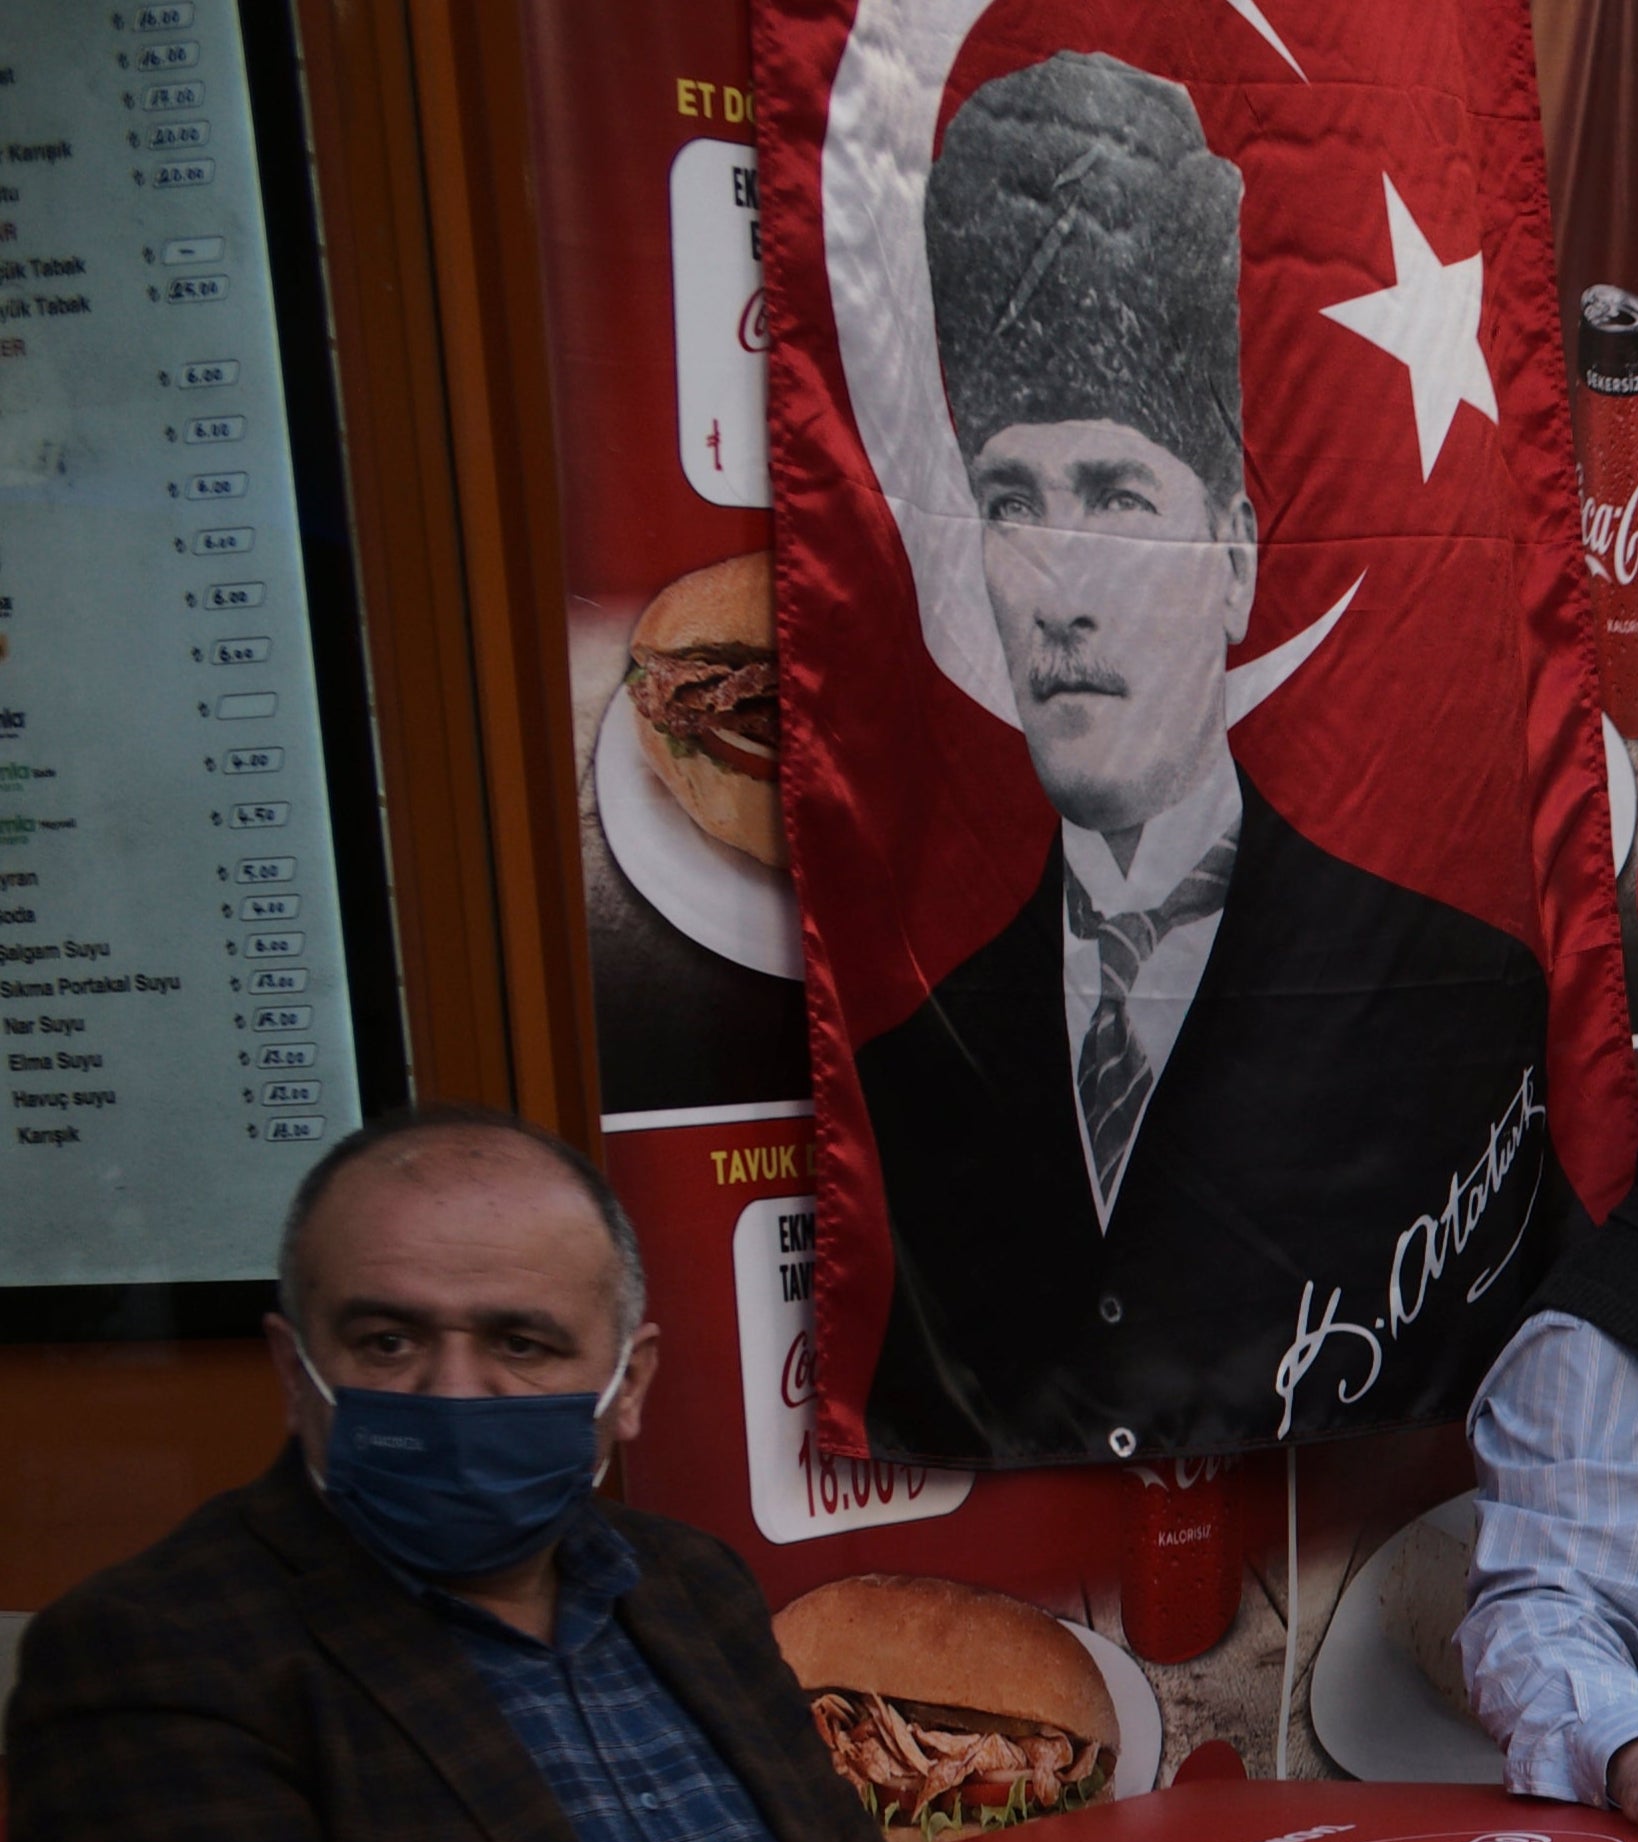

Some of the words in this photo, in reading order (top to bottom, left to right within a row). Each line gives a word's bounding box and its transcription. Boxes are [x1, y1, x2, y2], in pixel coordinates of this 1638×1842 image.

[675, 77, 717, 120] ET
[0, 872, 38, 892] yran
[0, 906, 35, 924] oda
[63, 940, 111, 962] Suyu
[58, 975, 131, 995] Portakal
[135, 973, 181, 995] Suyu
[4, 1016, 34, 1035] Nar
[39, 1015, 85, 1037] Suyu
[9, 1053, 52, 1071] Elma
[57, 1052, 103, 1073] Suyu
[710, 1148, 800, 1186] TAVUK
